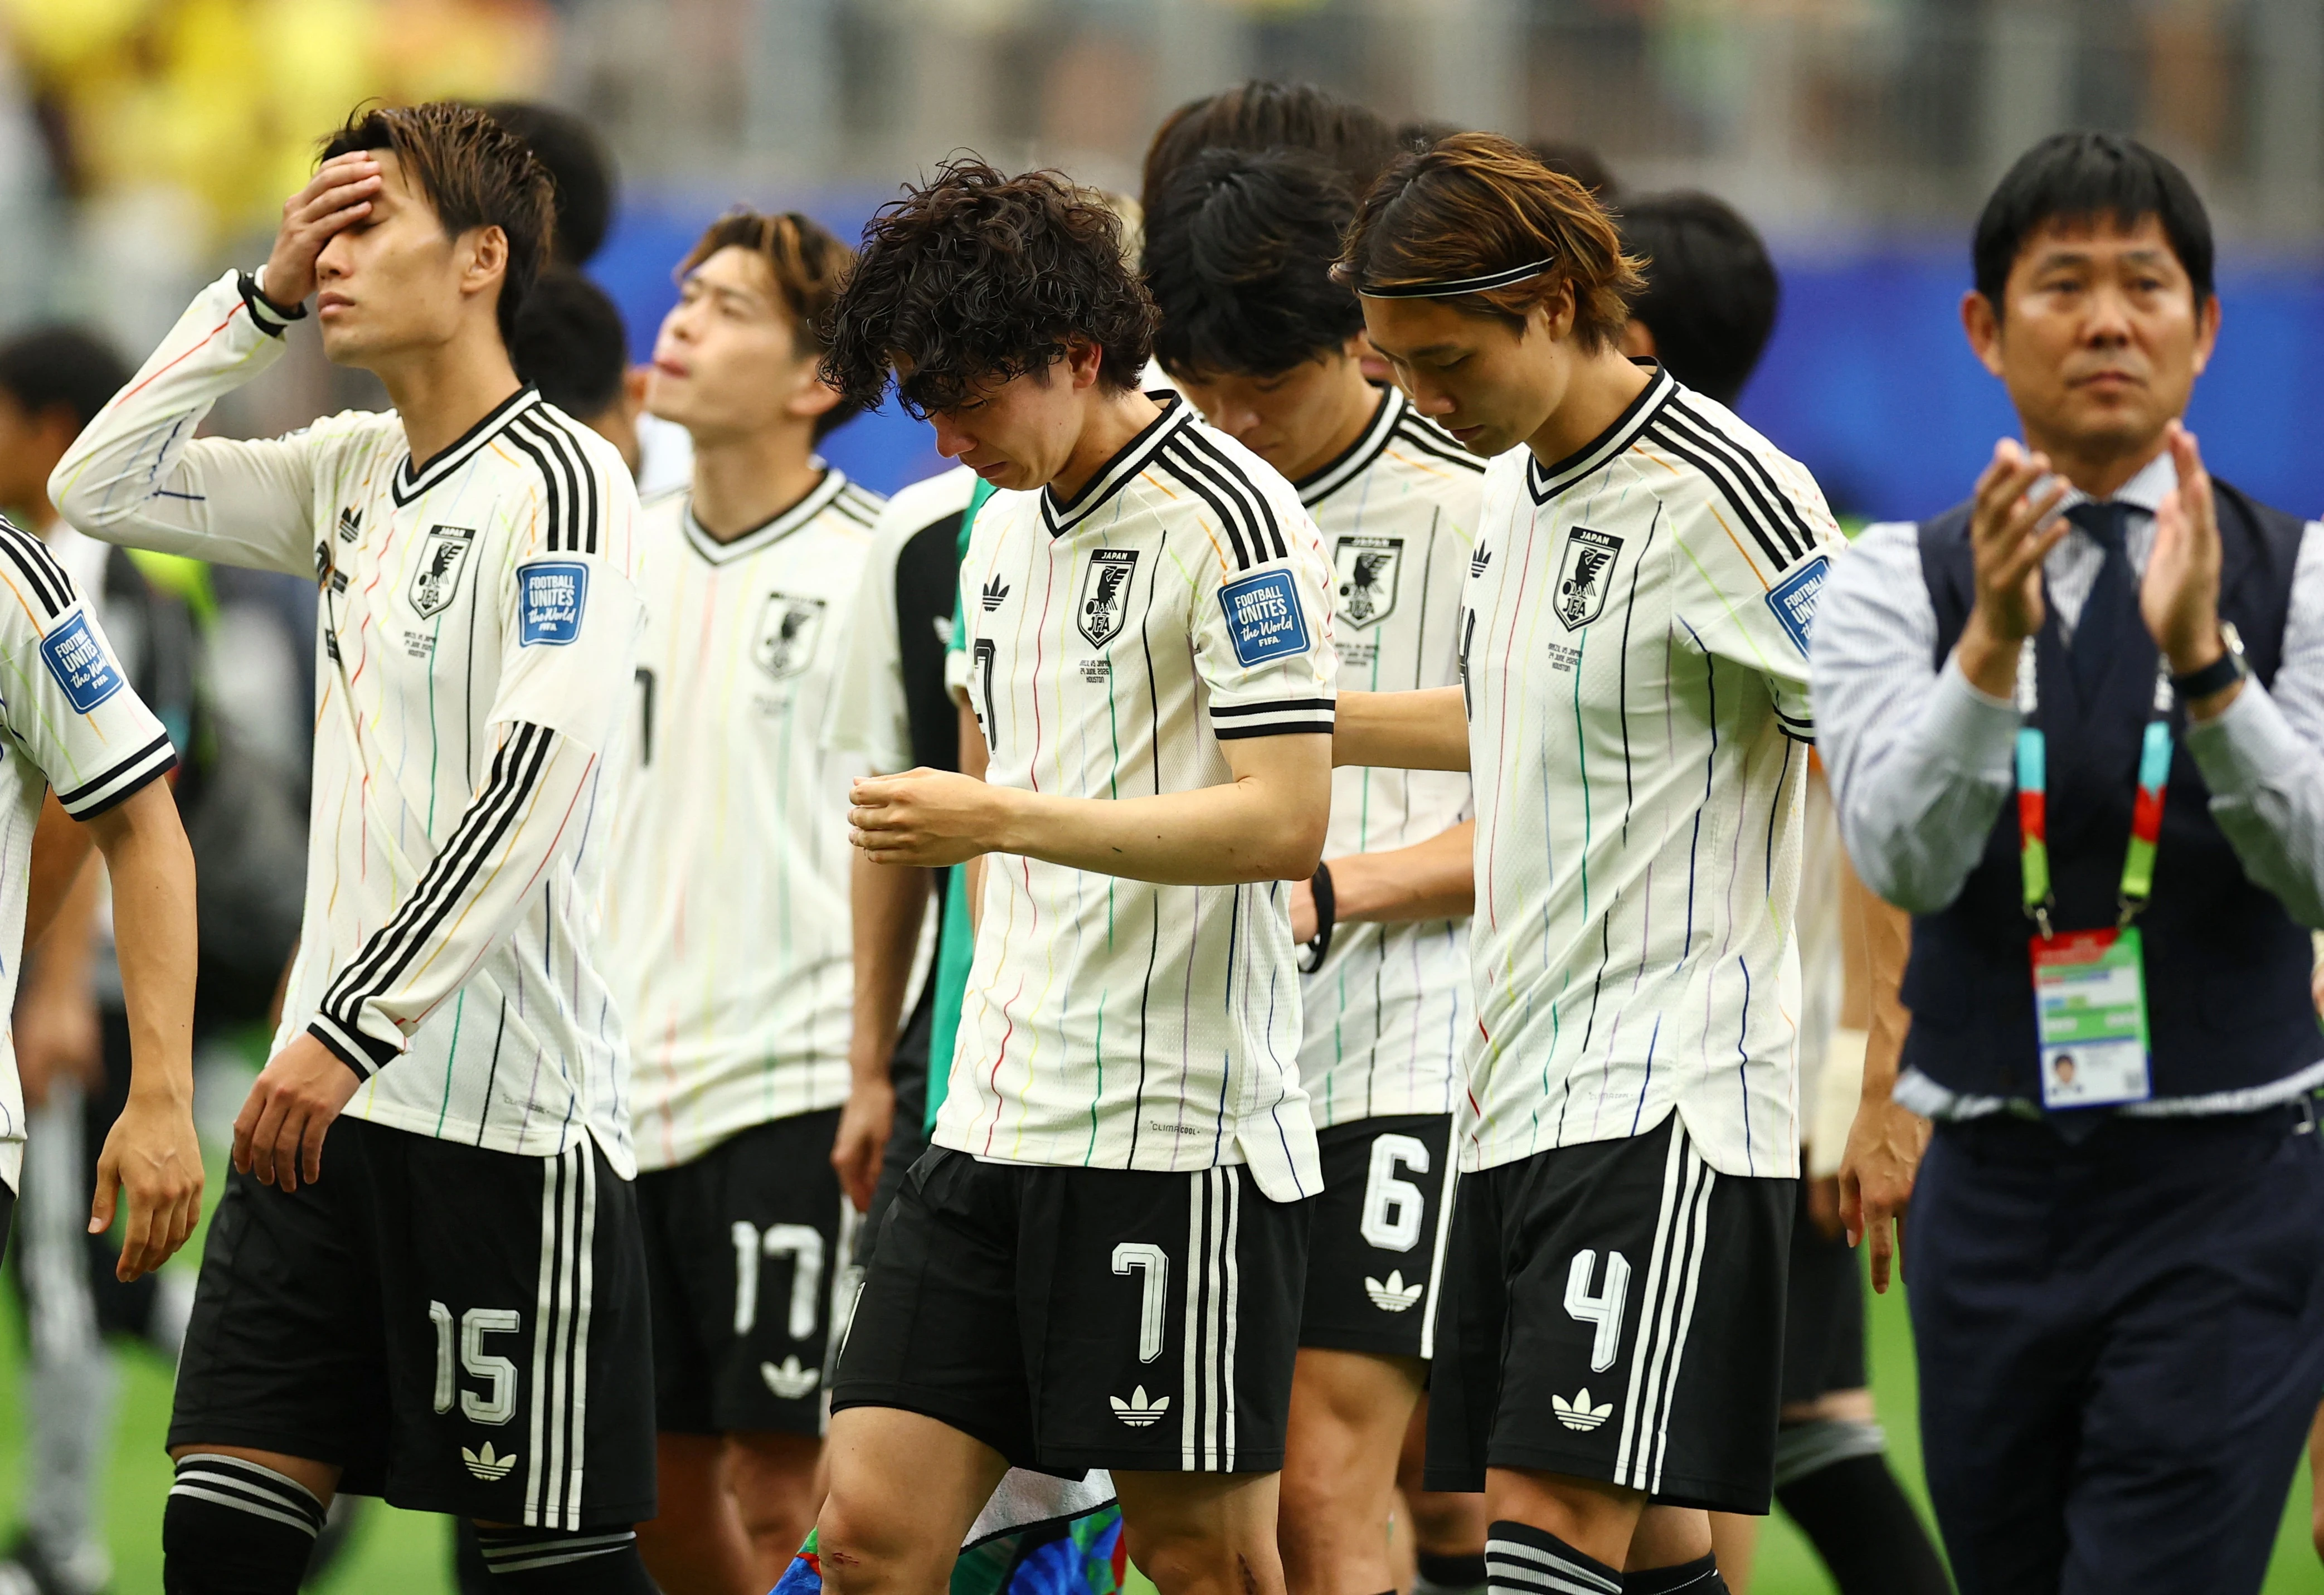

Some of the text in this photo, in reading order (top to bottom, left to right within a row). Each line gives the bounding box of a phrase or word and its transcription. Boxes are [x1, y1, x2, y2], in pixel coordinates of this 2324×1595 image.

[439, 527, 466, 537] JAPAN
[1579, 531, 1610, 545] JAPAN
[1101, 552, 1128, 561] JAPAN
[529, 575, 575, 590] FOOTBALL
[529, 589, 575, 607] UNITES
[1234, 585, 1283, 609] FOOTBALL
[1562, 597, 1586, 617] JFA
[527, 606, 577, 624] the World
[1238, 598, 1287, 625] UNITES
[1087, 615, 1110, 633] JFA
[1241, 615, 1294, 642] the World
[1258, 635, 1279, 647] FIFA
[62, 638, 98, 673] UNITES
[70, 672, 90, 689] the
[91, 674, 109, 690] FIFA
[974, 638, 998, 755] 7
[1360, 1132, 1430, 1253] 6
[731, 1220, 826, 1341] 17
[1112, 1242, 1169, 1364] 7
[1563, 1248, 1632, 1373] 4
[429, 1299, 521, 1426] 15
